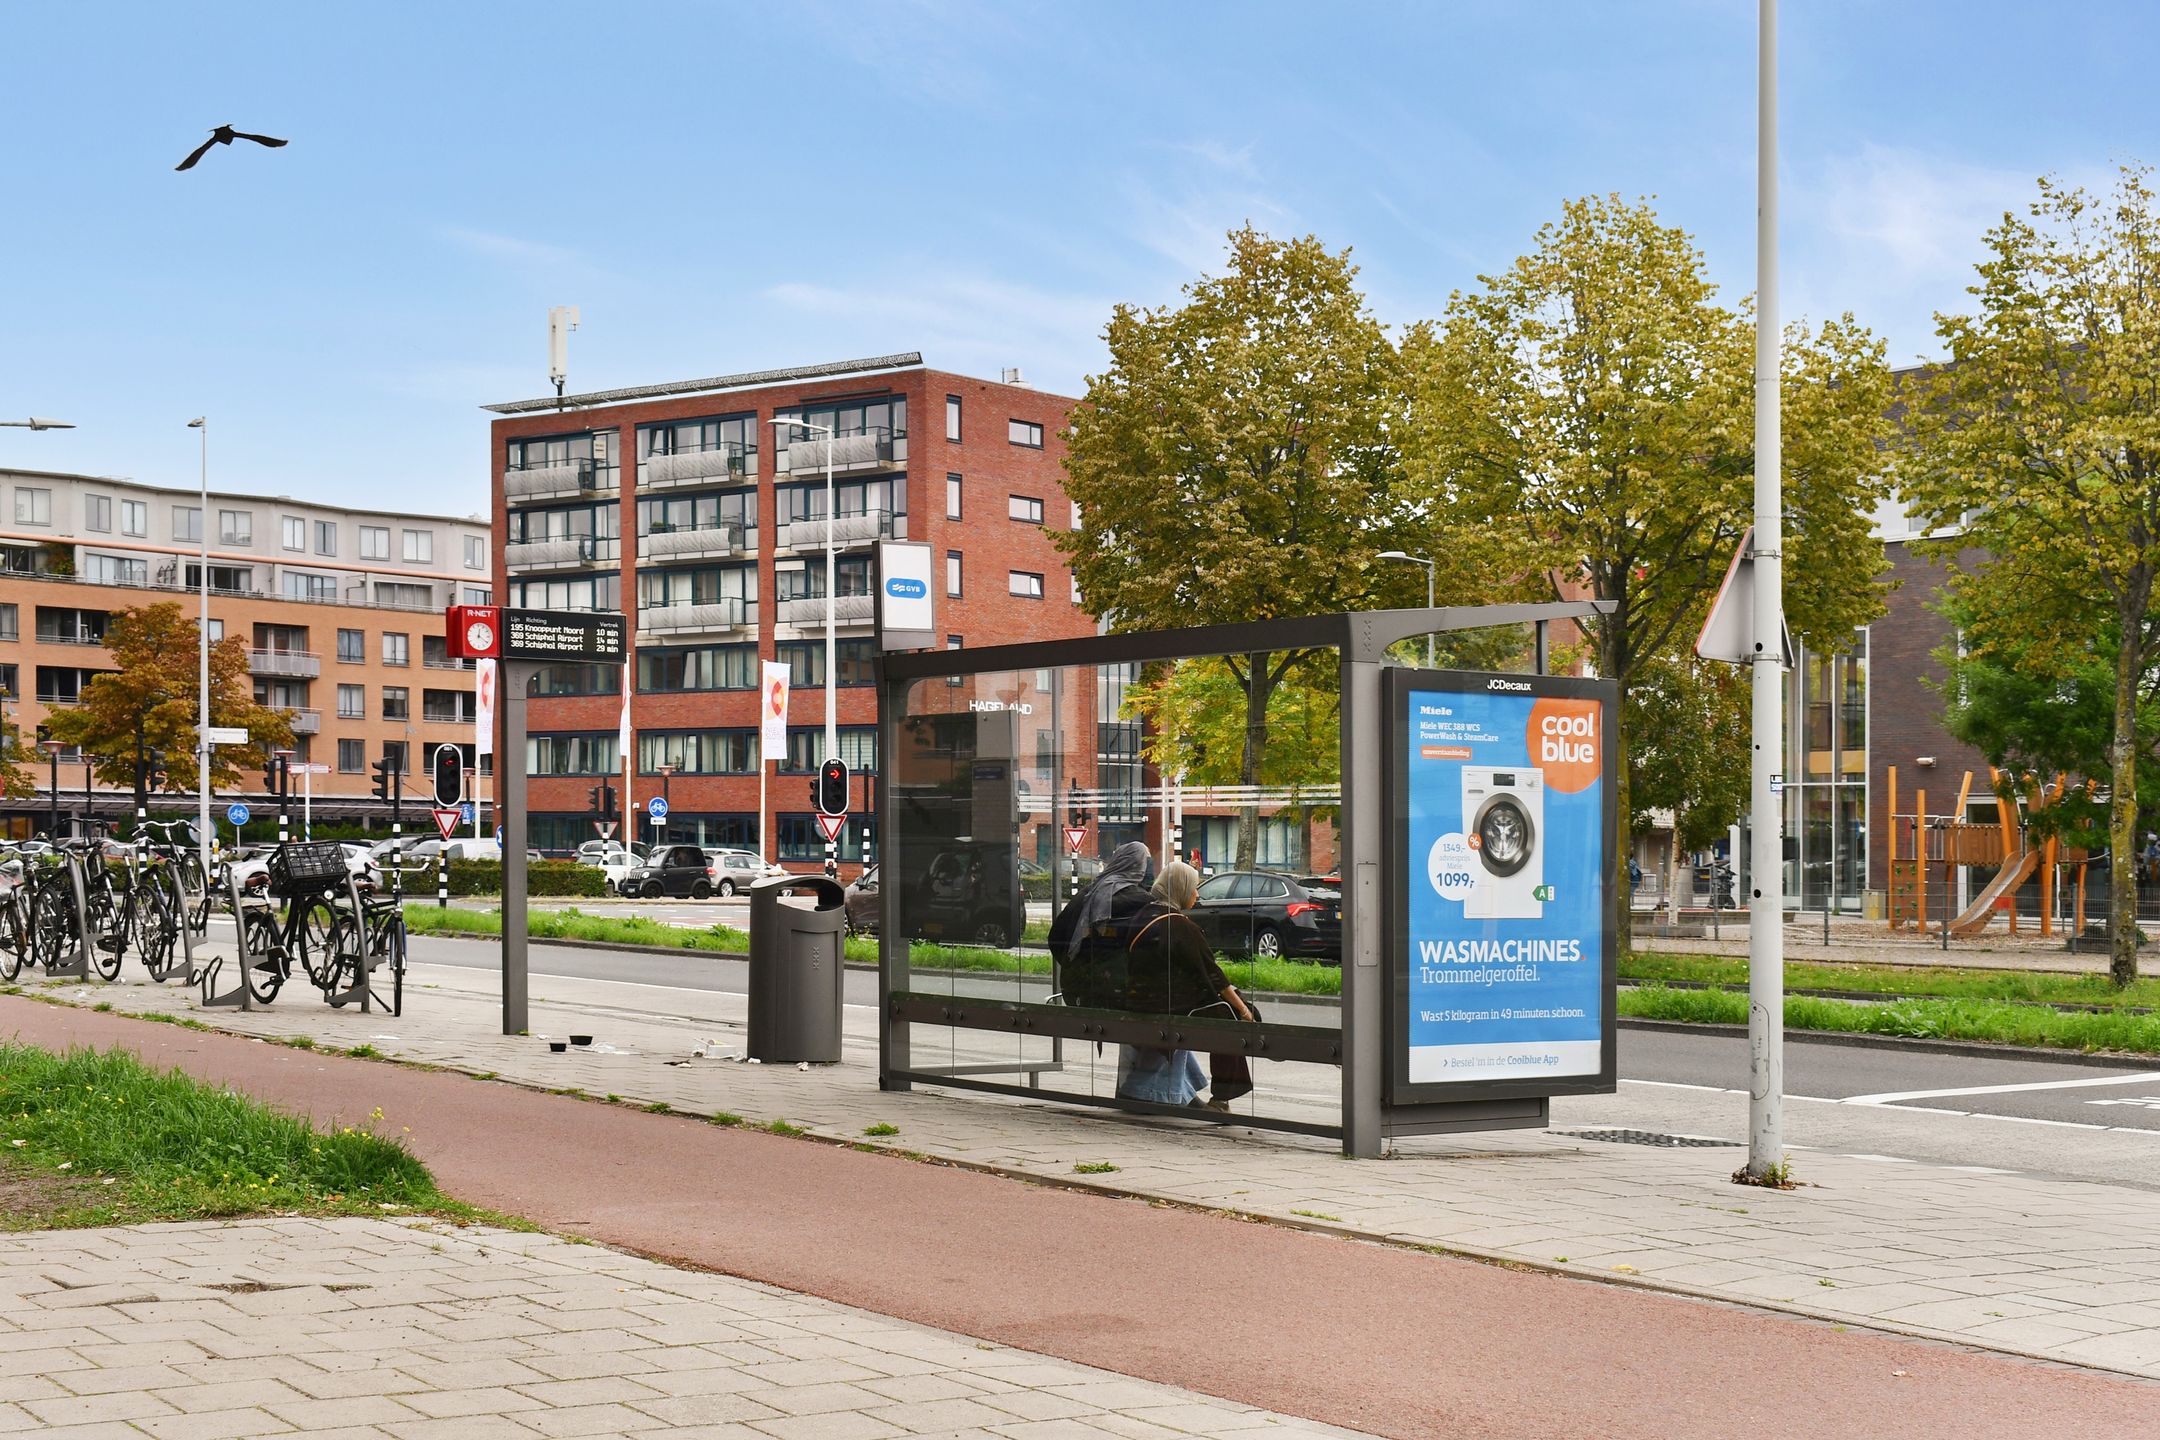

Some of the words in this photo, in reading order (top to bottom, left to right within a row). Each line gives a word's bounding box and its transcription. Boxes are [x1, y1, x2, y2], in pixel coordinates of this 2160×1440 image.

[526, 616, 547, 625] Richting
[525, 624, 562, 633] Knooppunt
[564, 626, 584, 634] Noord
[525, 632, 555, 641] Schiphol
[558, 634, 583, 642] Airport
[525, 641, 555, 649] Schiphol
[558, 642, 583, 650] Airport
[1487, 679, 1532, 691] JCDecaux
[1420, 706, 1452, 716] Miele
[1420, 721, 1437, 730] Miele
[1438, 722, 1452, 730] WEC
[1466, 723, 1481, 732] WCS
[1542, 713, 1594, 737] cool
[1420, 731, 1456, 740] PowerWash
[1464, 733, 1499, 742] SteamCare
[1542, 736, 1594, 763] blue
[1470, 836, 1480, 846] %
[1539, 889, 1546, 898] A
[1419, 939, 1586, 963] WASMACHINES.
[1420, 964, 1540, 987] Trommelgeroffel.
[1421, 1010, 1444, 1022] Wast
[1451, 1009, 1489, 1023] kilogram
[1490, 1009, 1499, 1020] in
[1500, 1009, 1511, 1019] 49
[1514, 1007, 1550, 1019] minuten
[1552, 1007, 1586, 1018] schoon.
[1451, 1057, 1474, 1068] Bestel
[1487, 1057, 1495, 1066] in
[1496, 1056, 1505, 1066] de
[1507, 1055, 1542, 1066] Coolblue
[1543, 1055, 1559, 1066] App
